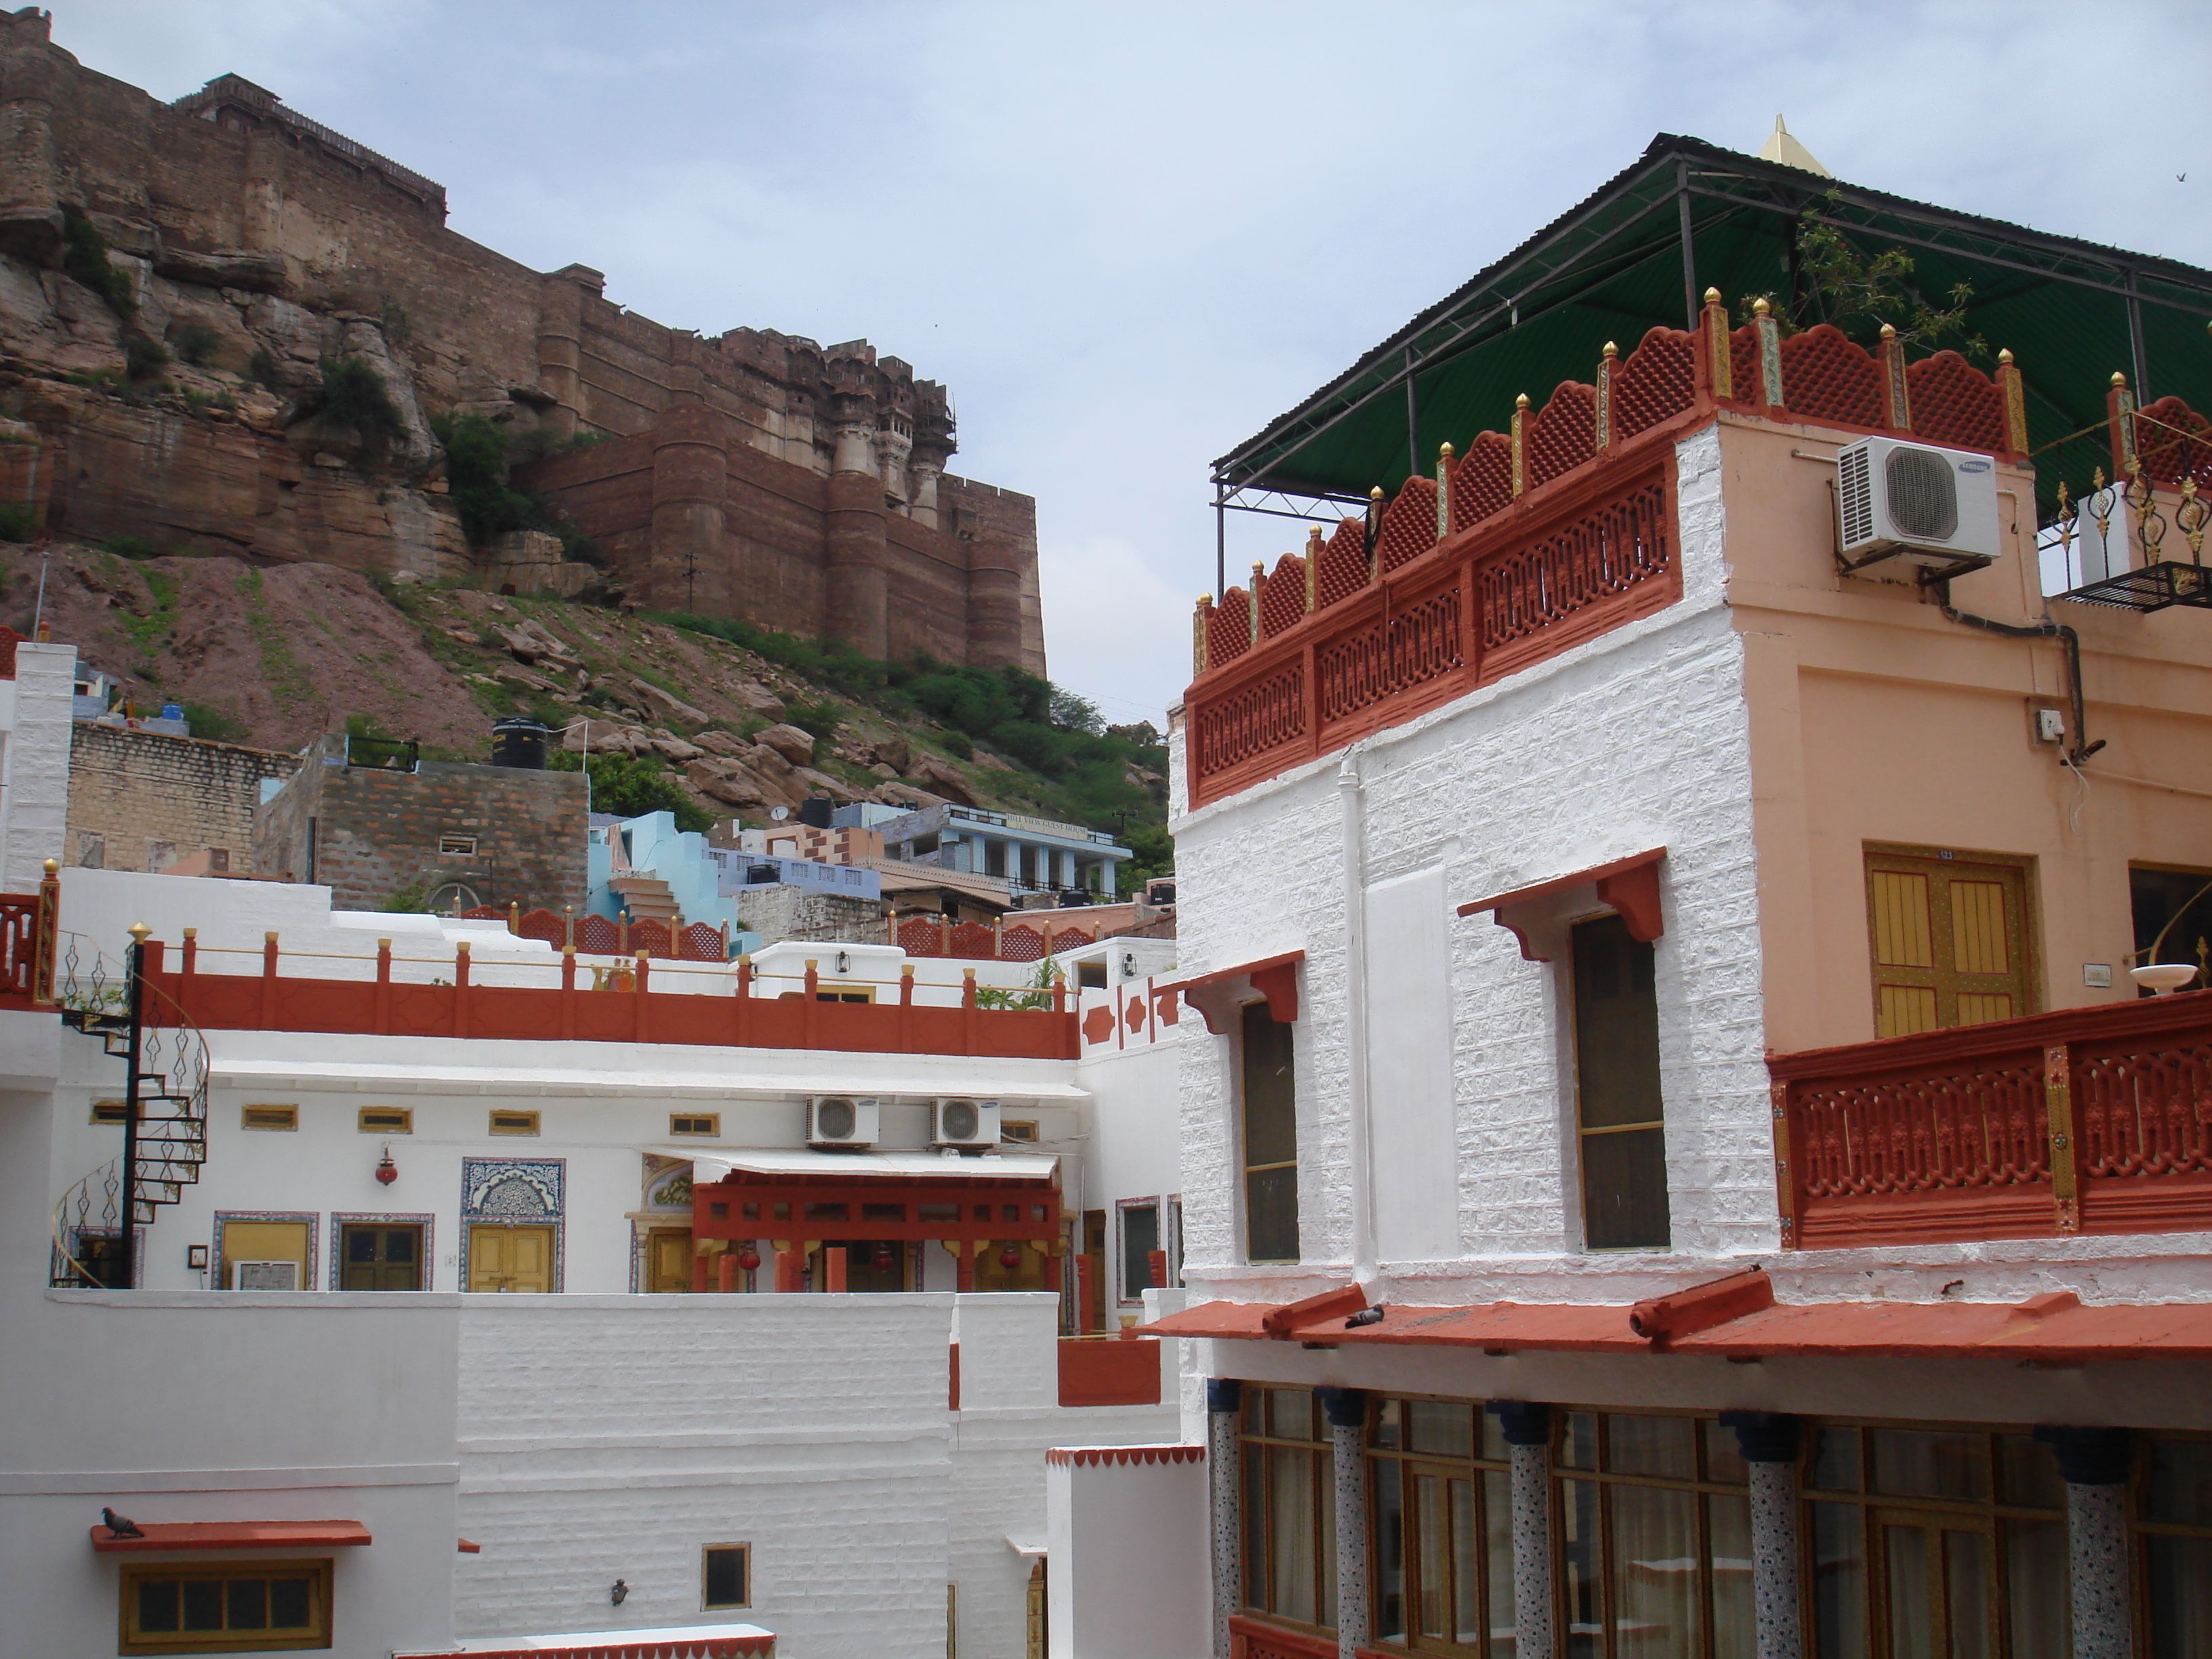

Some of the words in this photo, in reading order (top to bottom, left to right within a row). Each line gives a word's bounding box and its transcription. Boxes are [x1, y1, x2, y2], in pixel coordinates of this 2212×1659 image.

[1962, 462, 1988, 472] SAMSUNG
[1007, 814, 1021, 823] HILL
[1024, 817, 1041, 825] VIEW
[1042, 821, 1063, 830] GUEST
[1065, 825, 1086, 835] HOUSE
